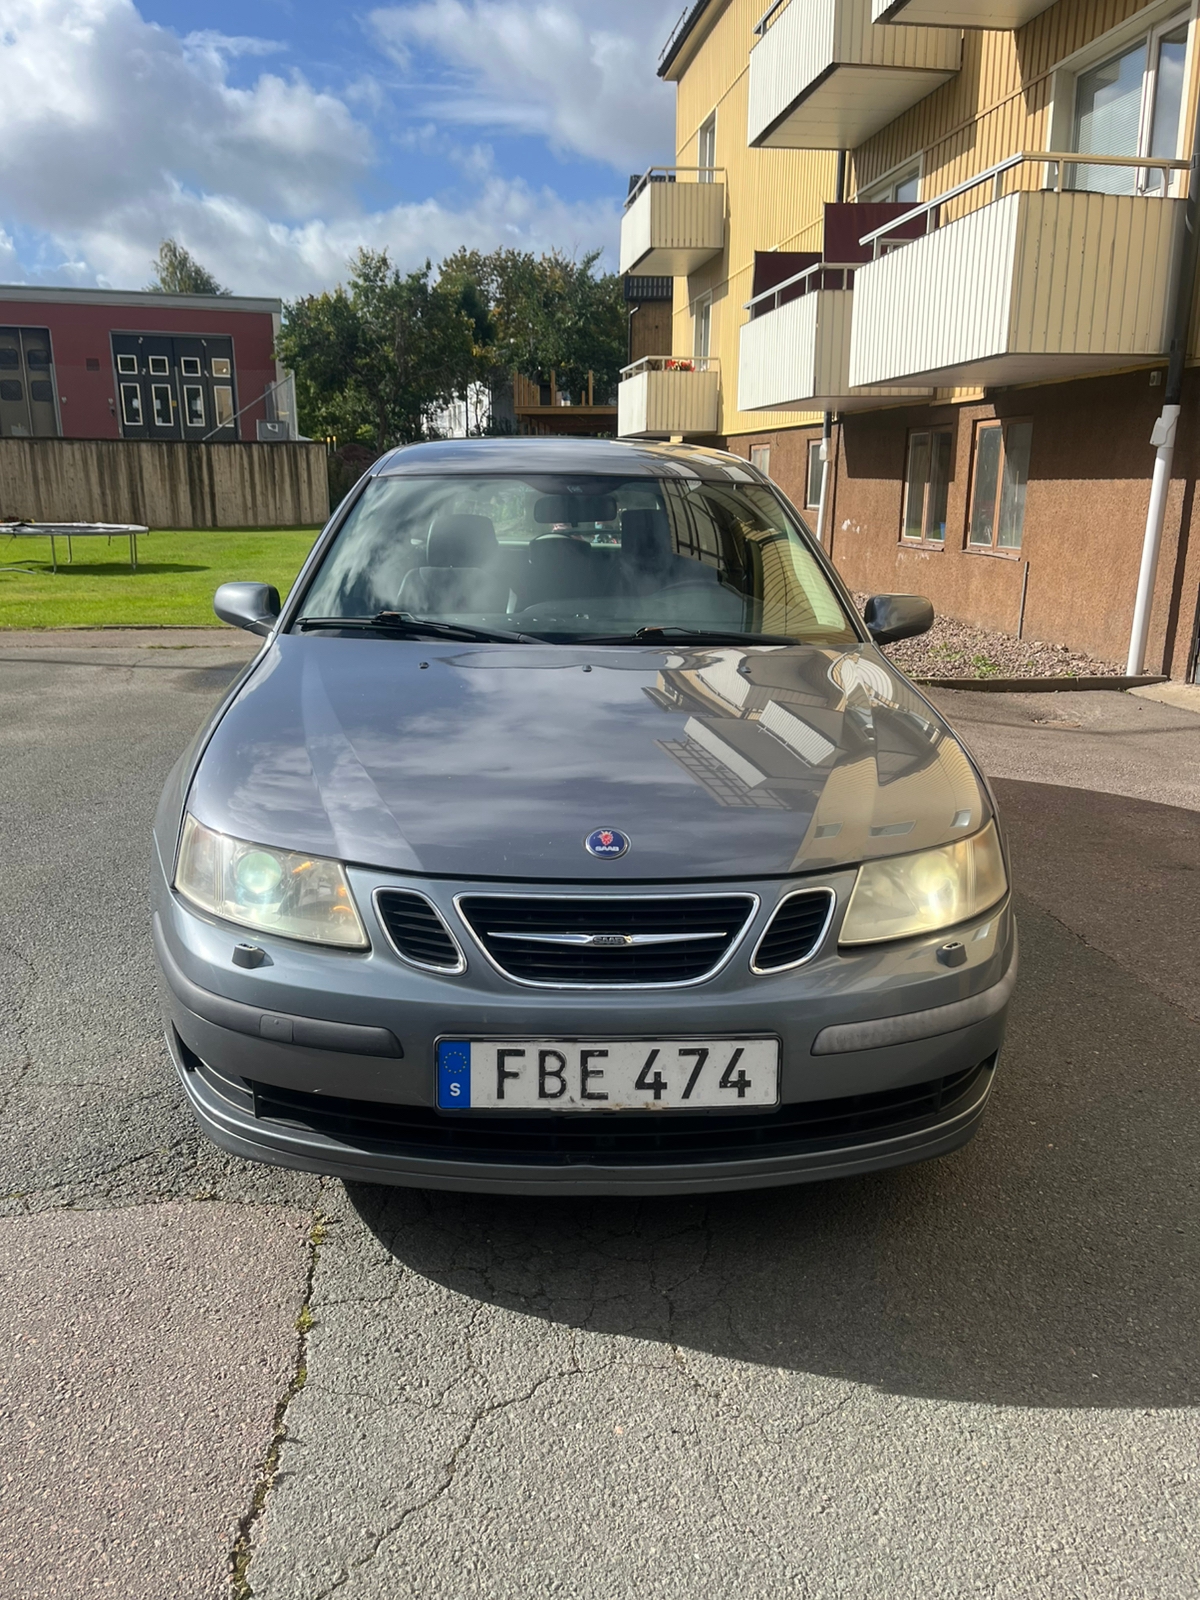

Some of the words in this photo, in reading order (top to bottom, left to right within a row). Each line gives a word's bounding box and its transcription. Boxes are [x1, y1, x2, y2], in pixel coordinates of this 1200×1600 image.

[450, 1083, 460, 1096] S
[496, 1048, 609, 1100] FBE
[634, 1048, 751, 1100] 474
